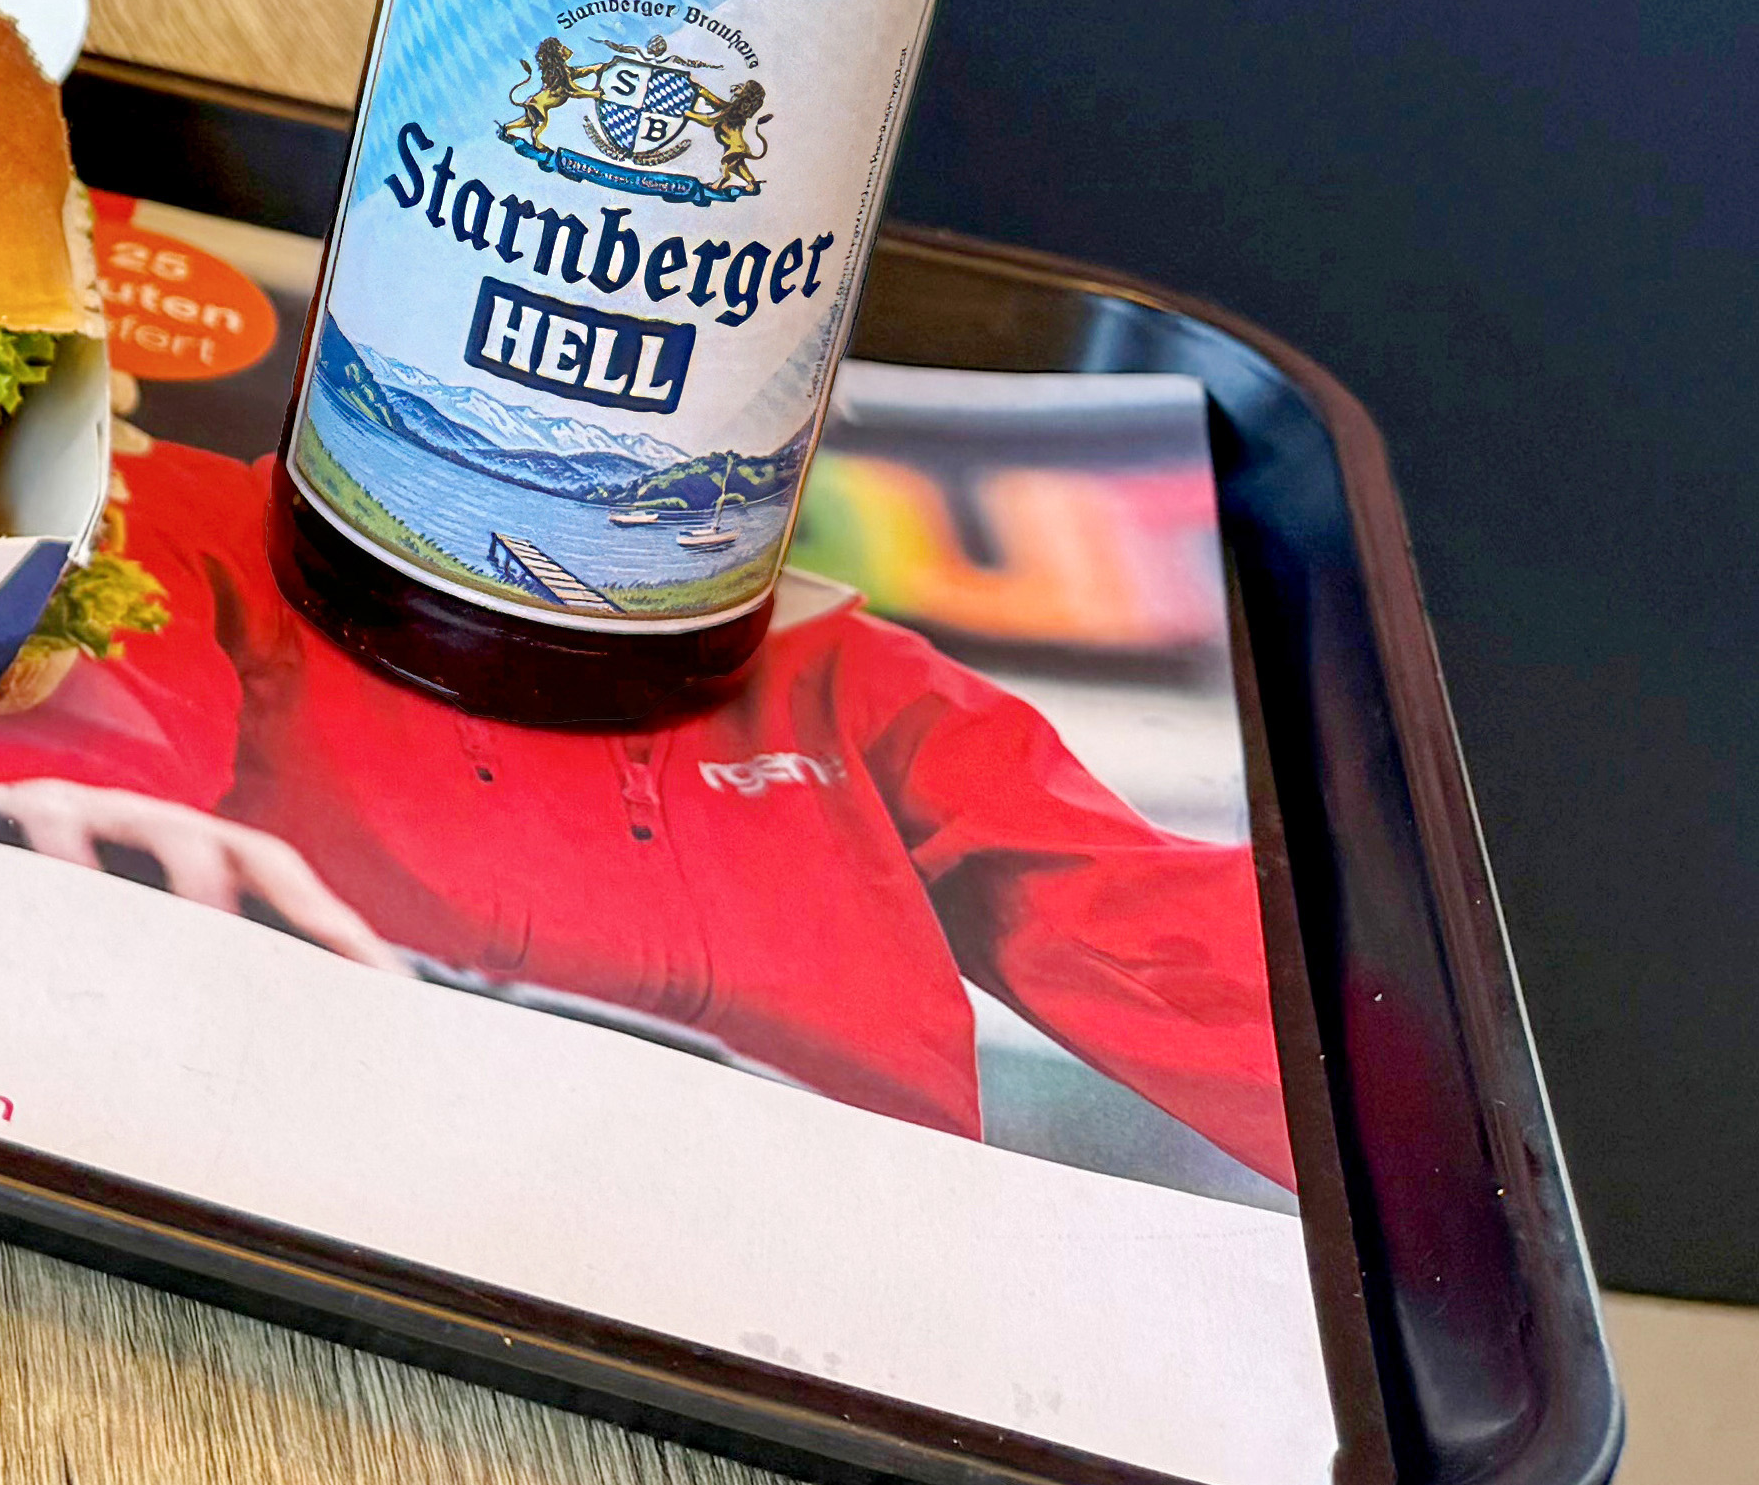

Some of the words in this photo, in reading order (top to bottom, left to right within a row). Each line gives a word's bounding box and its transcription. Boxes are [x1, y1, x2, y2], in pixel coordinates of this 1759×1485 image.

[611, 69, 640, 96] S
[641, 116, 668, 141] B
[384, 122, 834, 327] Starnberger
[97, 277, 245, 335] uten
[108, 313, 216, 366] fort
[481, 295, 678, 402] HELL
